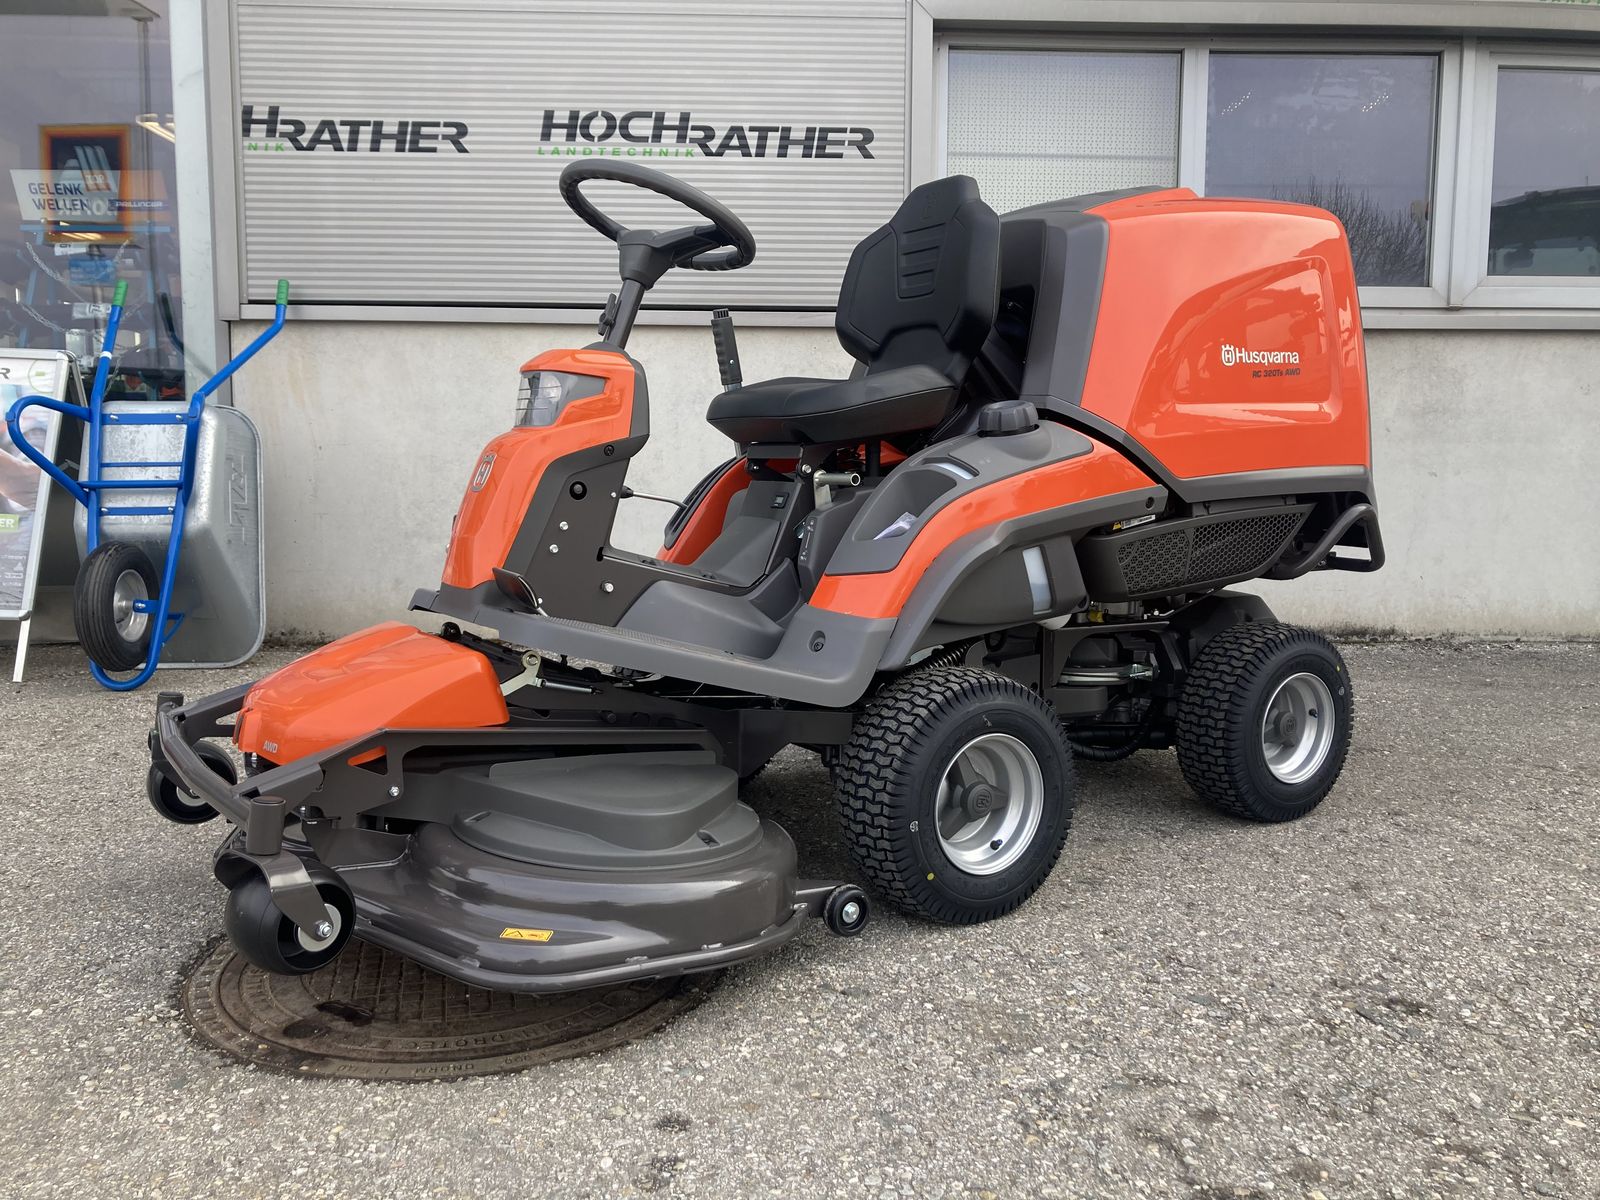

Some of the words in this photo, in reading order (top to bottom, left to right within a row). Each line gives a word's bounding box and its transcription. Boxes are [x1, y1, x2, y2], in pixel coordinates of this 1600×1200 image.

[540, 110, 875, 159] HOCHRATHER
[537, 146, 696, 158] LANDTECHNIK
[28, 182, 83, 195] GELENK
[32, 199, 89, 211] WELLEN
[1235, 347, 1299, 366] Husqvarna
[1285, 368, 1301, 376] AWD
[262, 739, 279, 754] AWD
